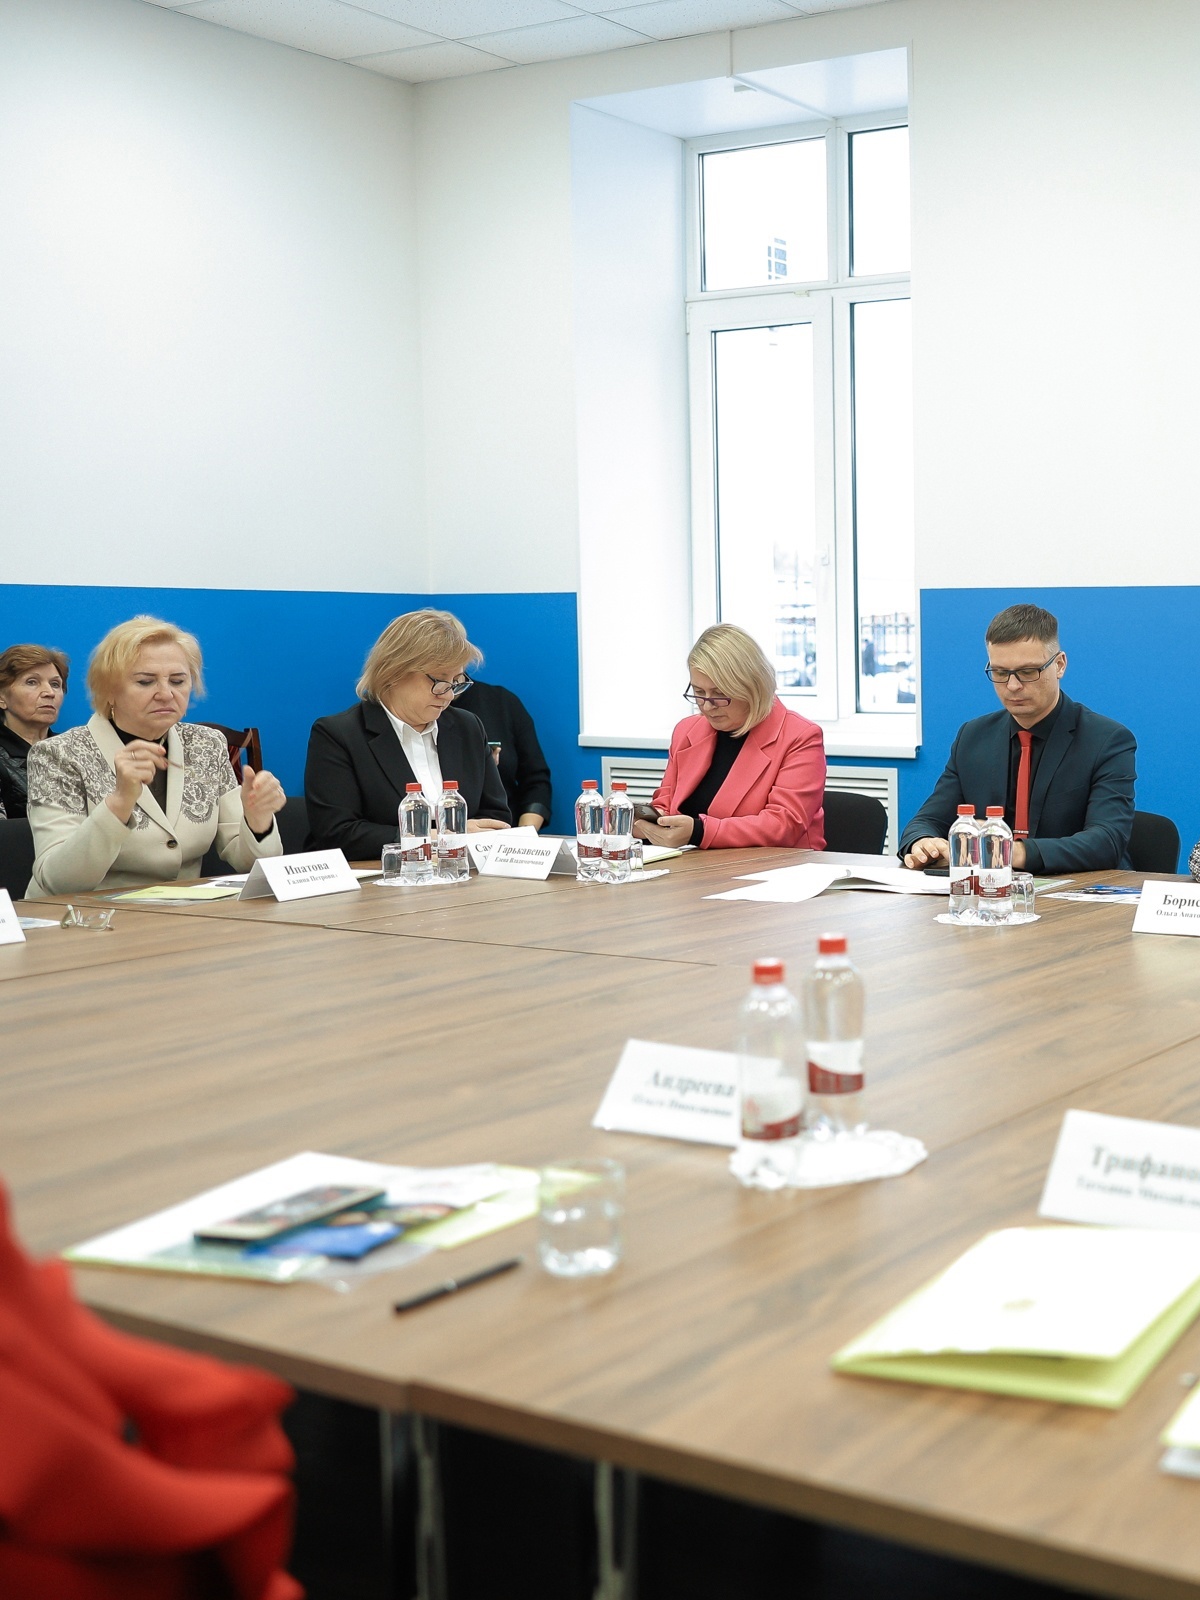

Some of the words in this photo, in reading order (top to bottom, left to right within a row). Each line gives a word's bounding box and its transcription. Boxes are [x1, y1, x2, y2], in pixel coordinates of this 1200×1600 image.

[497, 844, 551, 857] Гарькавенко
[284, 862, 330, 875] Ипатова
[287, 877, 310, 885] Галина
[1156, 909, 1178, 917] Ольга
